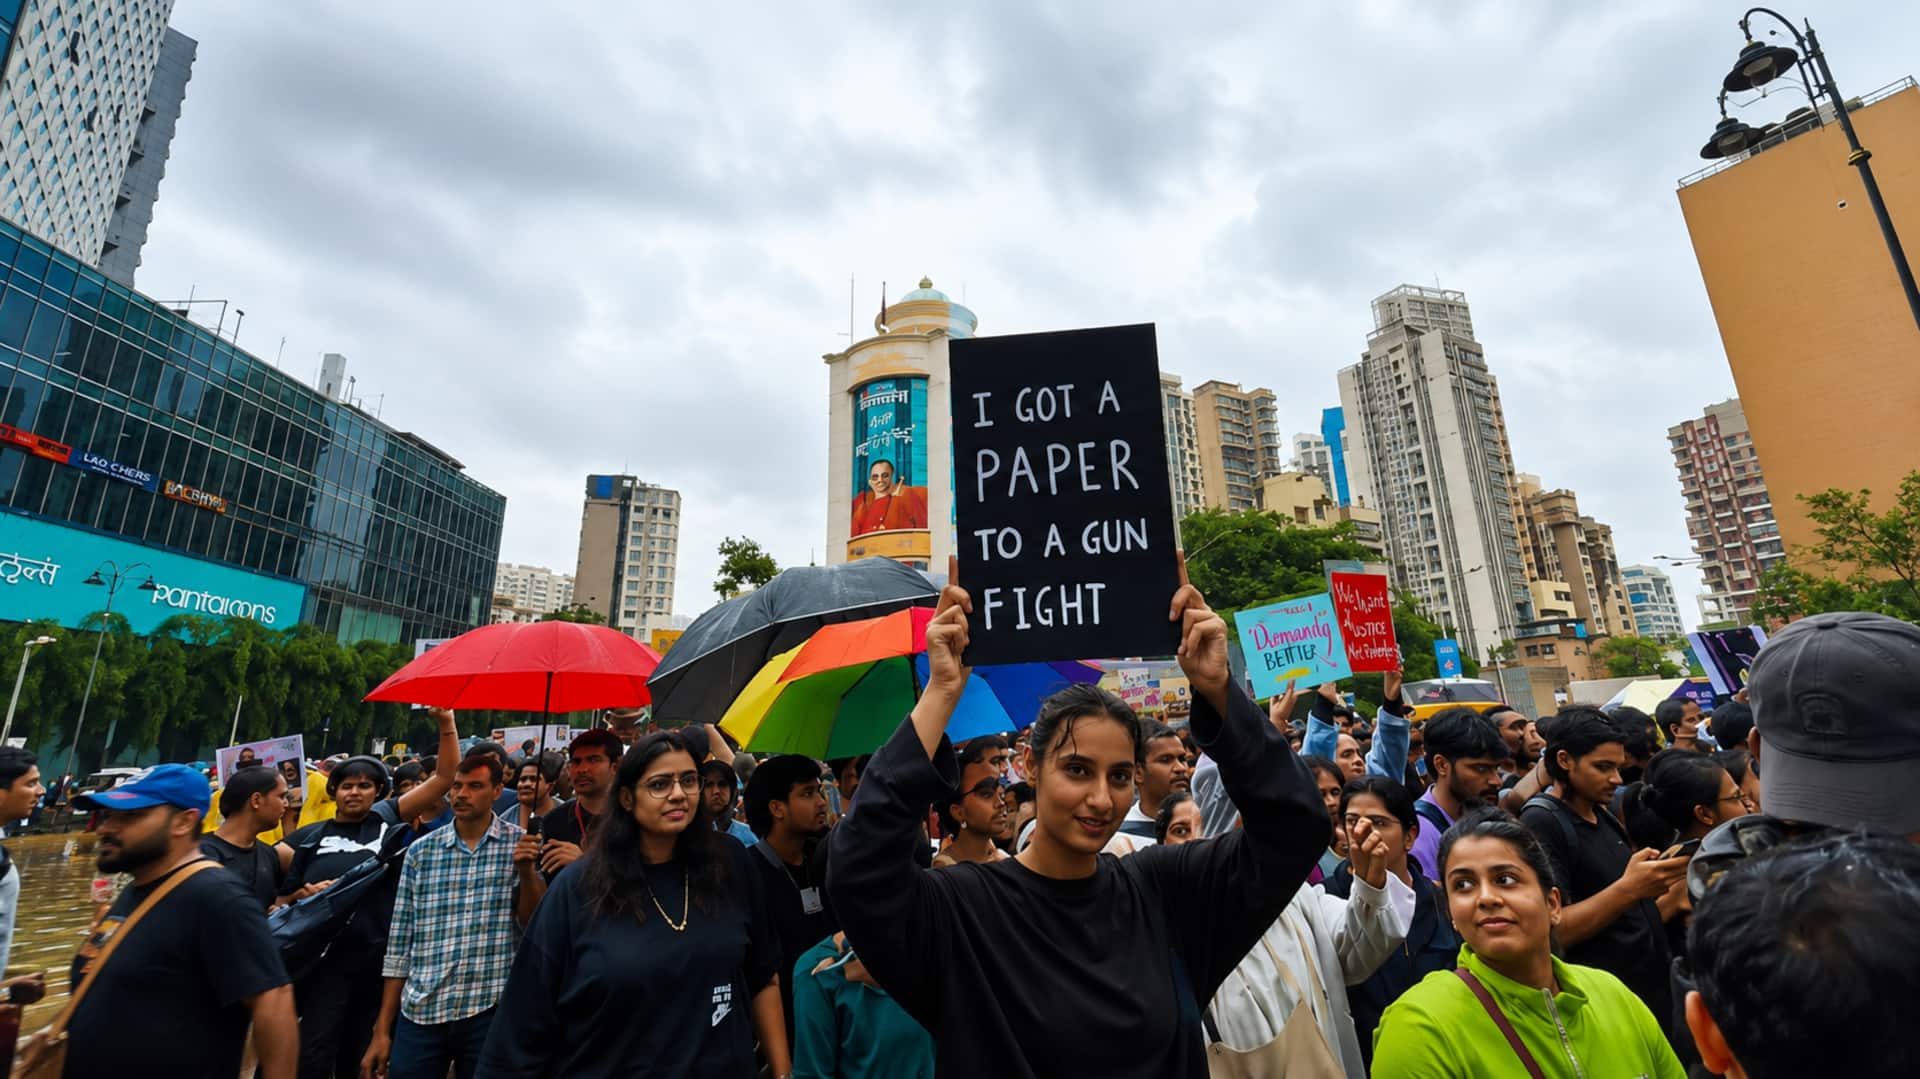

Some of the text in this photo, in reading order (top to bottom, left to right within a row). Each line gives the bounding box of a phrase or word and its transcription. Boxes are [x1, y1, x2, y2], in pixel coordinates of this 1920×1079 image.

[973, 380, 1121, 428] I GOT A
[976, 439, 1140, 502] PAPER
[973, 518, 1149, 561] TO A GUN
[984, 583, 1106, 630] FIGHT
